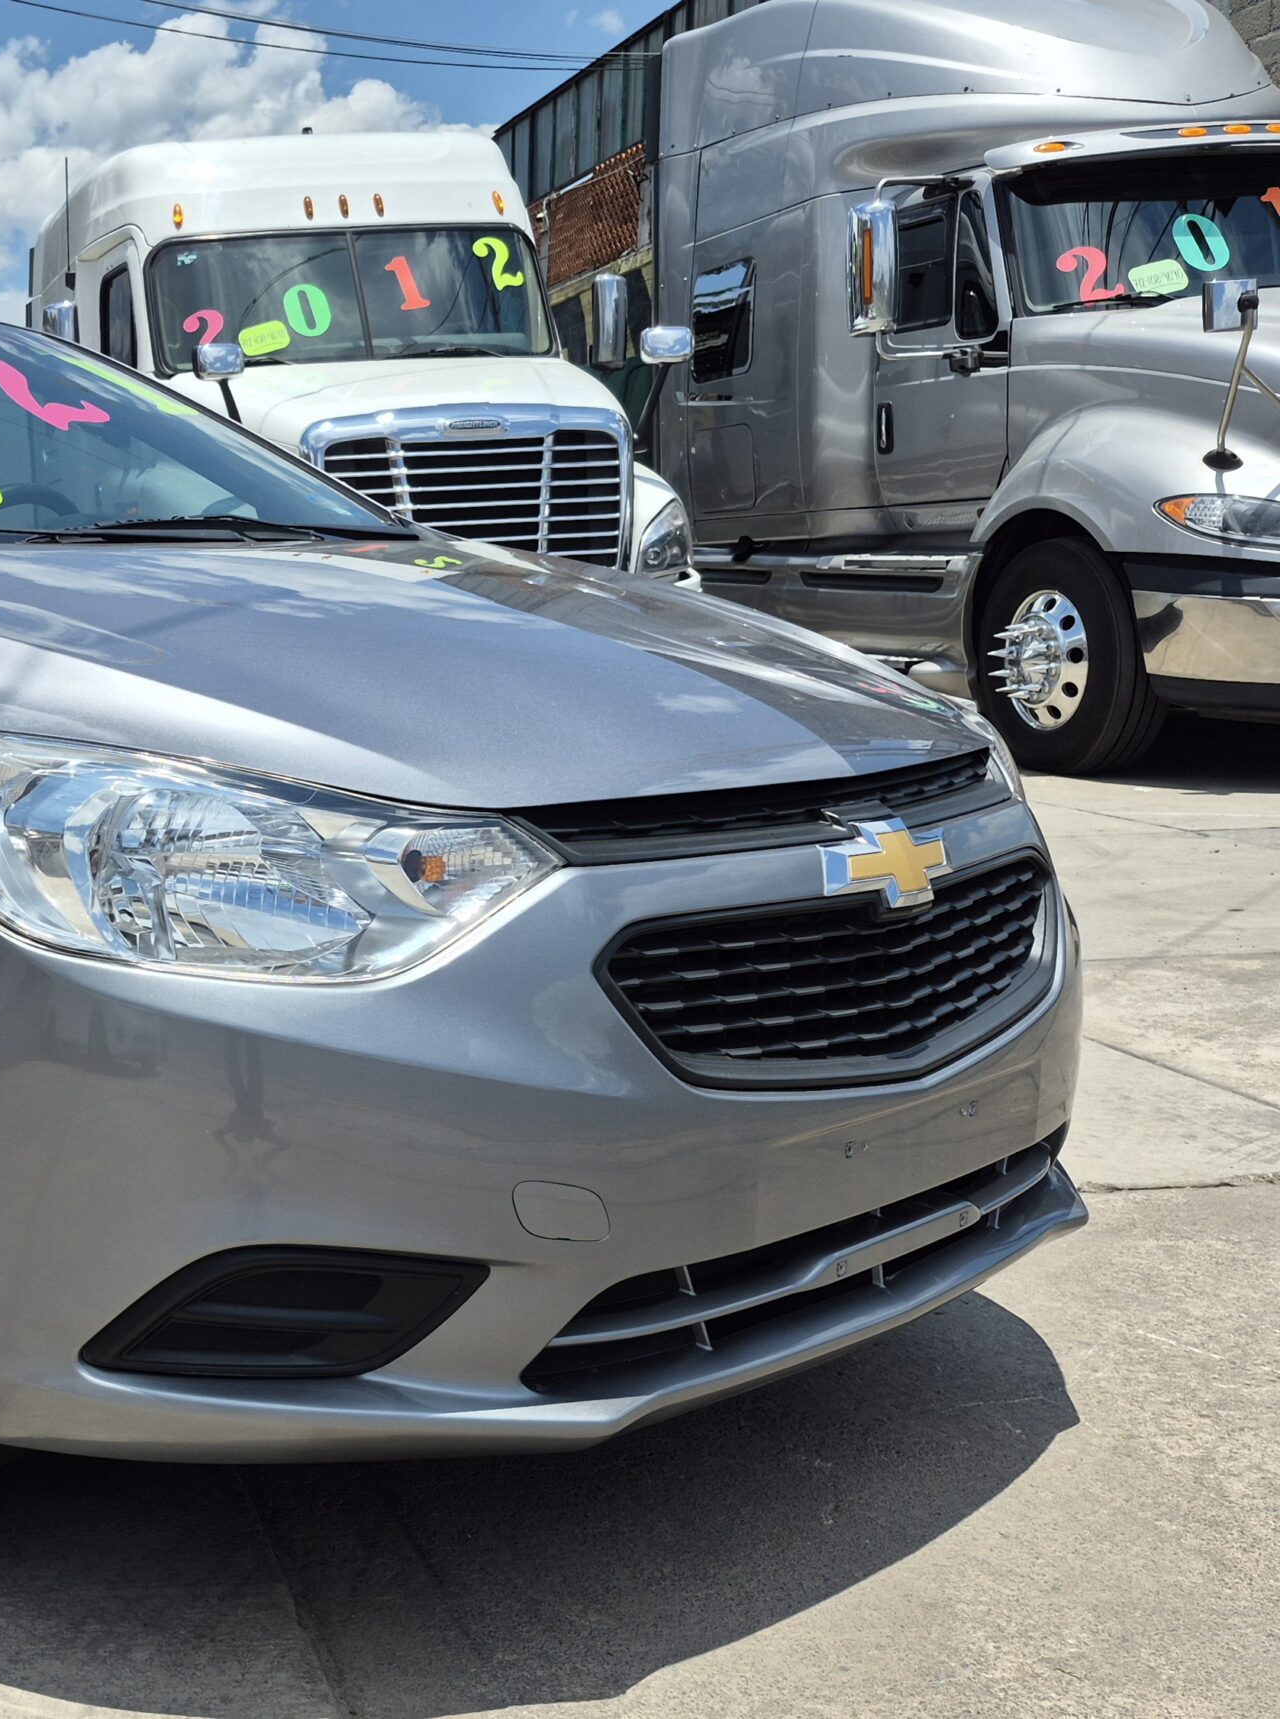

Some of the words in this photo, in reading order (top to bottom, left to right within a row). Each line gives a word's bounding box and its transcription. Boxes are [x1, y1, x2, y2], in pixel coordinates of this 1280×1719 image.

[283, 284, 332, 337] 0
[384, 256, 431, 310] 1
[472, 237, 524, 291] 2
[1056, 246, 1126, 305] 2
[1172, 213, 1230, 272] 0
